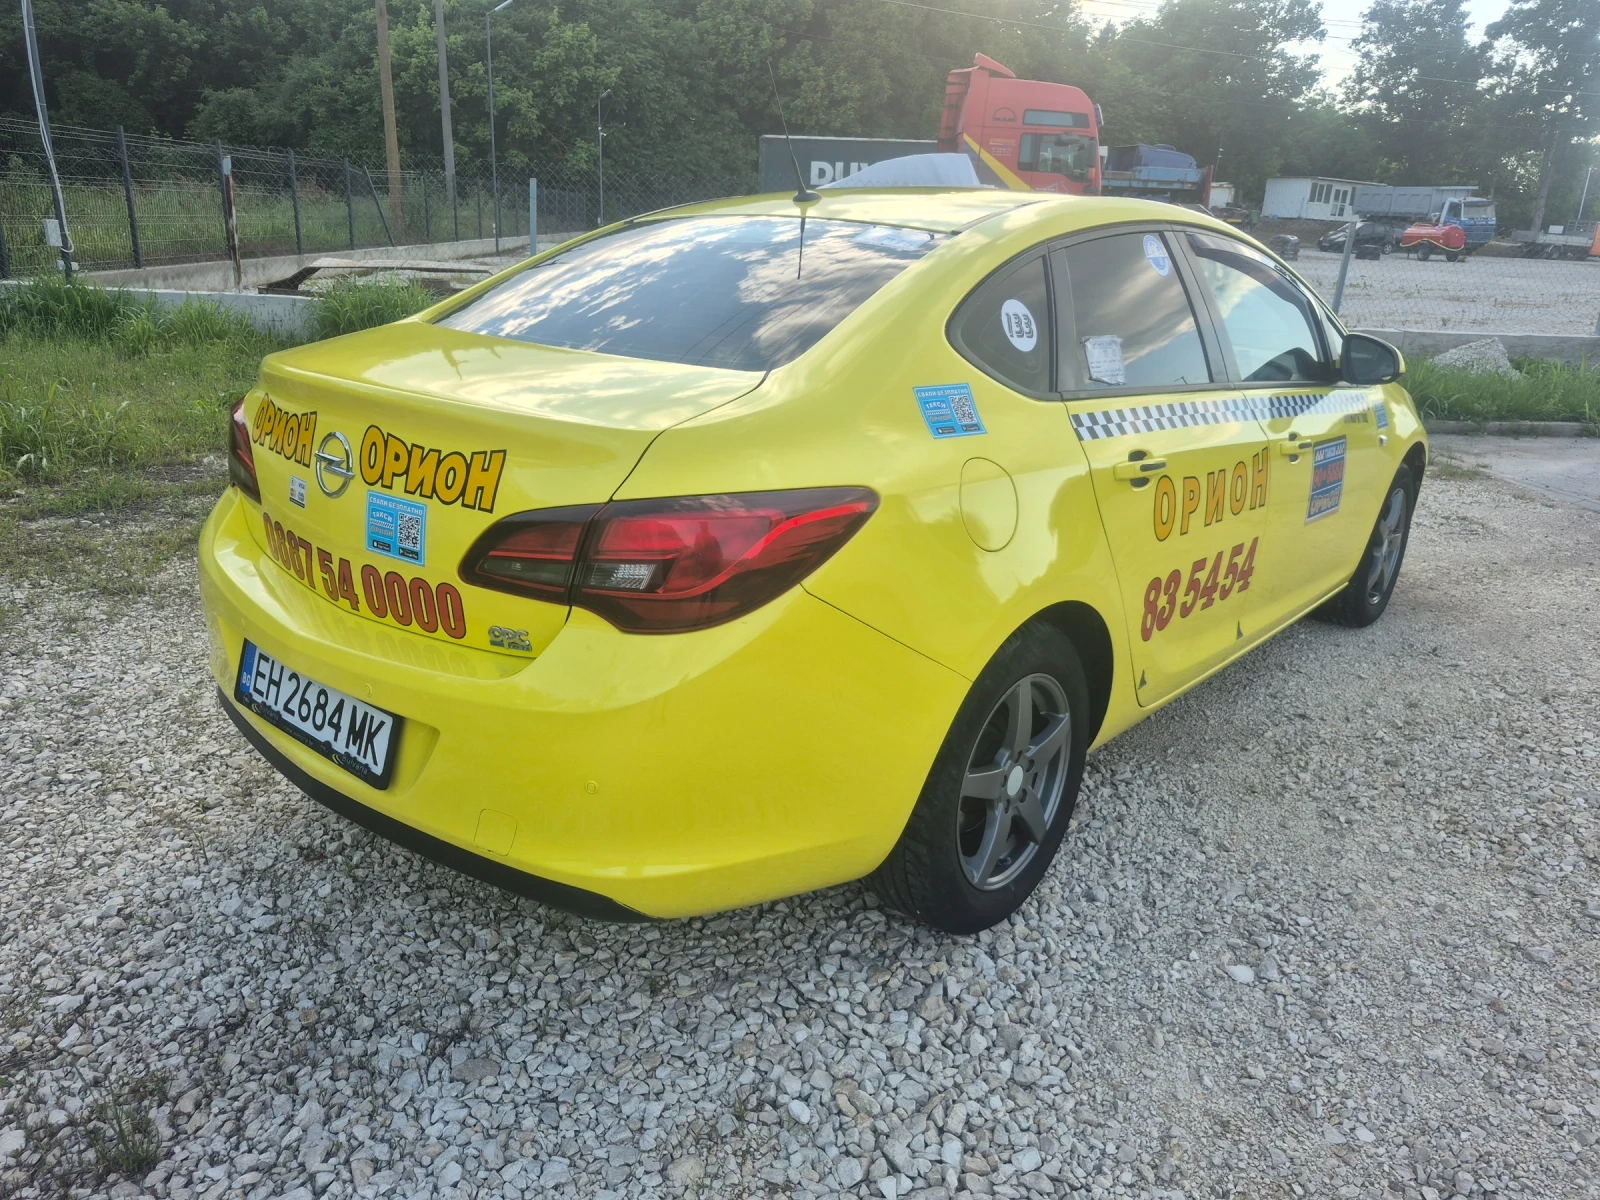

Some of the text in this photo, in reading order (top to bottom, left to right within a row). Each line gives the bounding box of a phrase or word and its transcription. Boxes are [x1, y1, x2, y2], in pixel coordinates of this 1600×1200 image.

[810, 161, 869, 185] DU
[1005, 312, 1034, 339] 133
[925, 401, 946, 409] ТАКСИ
[251, 392, 317, 468] ОРИОН
[359, 424, 507, 514] ОРИОН
[369, 496, 423, 516] СВАЛИ БЕЗПЛАТНО
[1154, 446, 1269, 542] ОРИОН
[372, 511, 393, 523] ТАКСИ
[371, 525, 394, 537] ОРИОН
[263, 512, 466, 639] 0887 54 0000
[242, 672, 250, 686] BG
